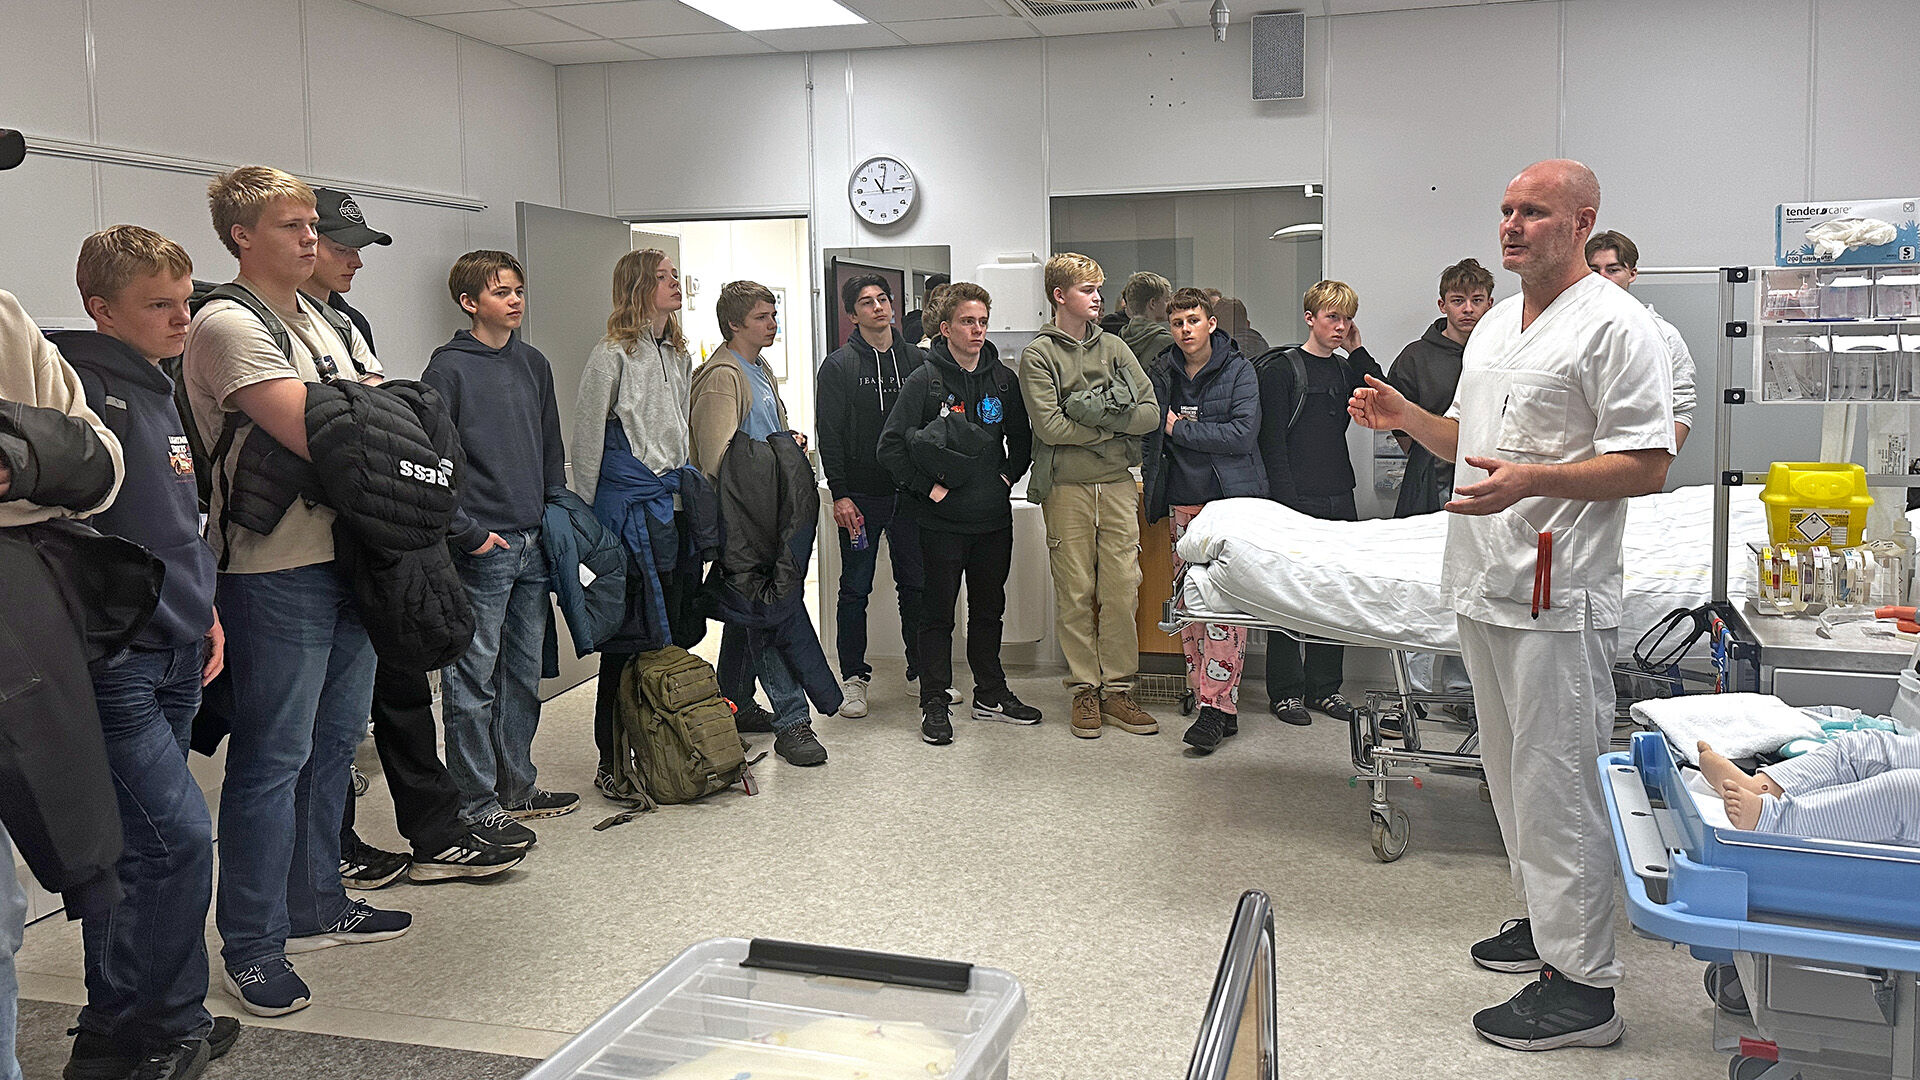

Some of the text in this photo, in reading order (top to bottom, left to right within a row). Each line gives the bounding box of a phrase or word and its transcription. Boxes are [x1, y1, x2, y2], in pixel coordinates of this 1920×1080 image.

[1786, 206, 1850, 217] tender care
[1903, 247, 1911, 256] S
[859, 376, 908, 386] JEAN PU
